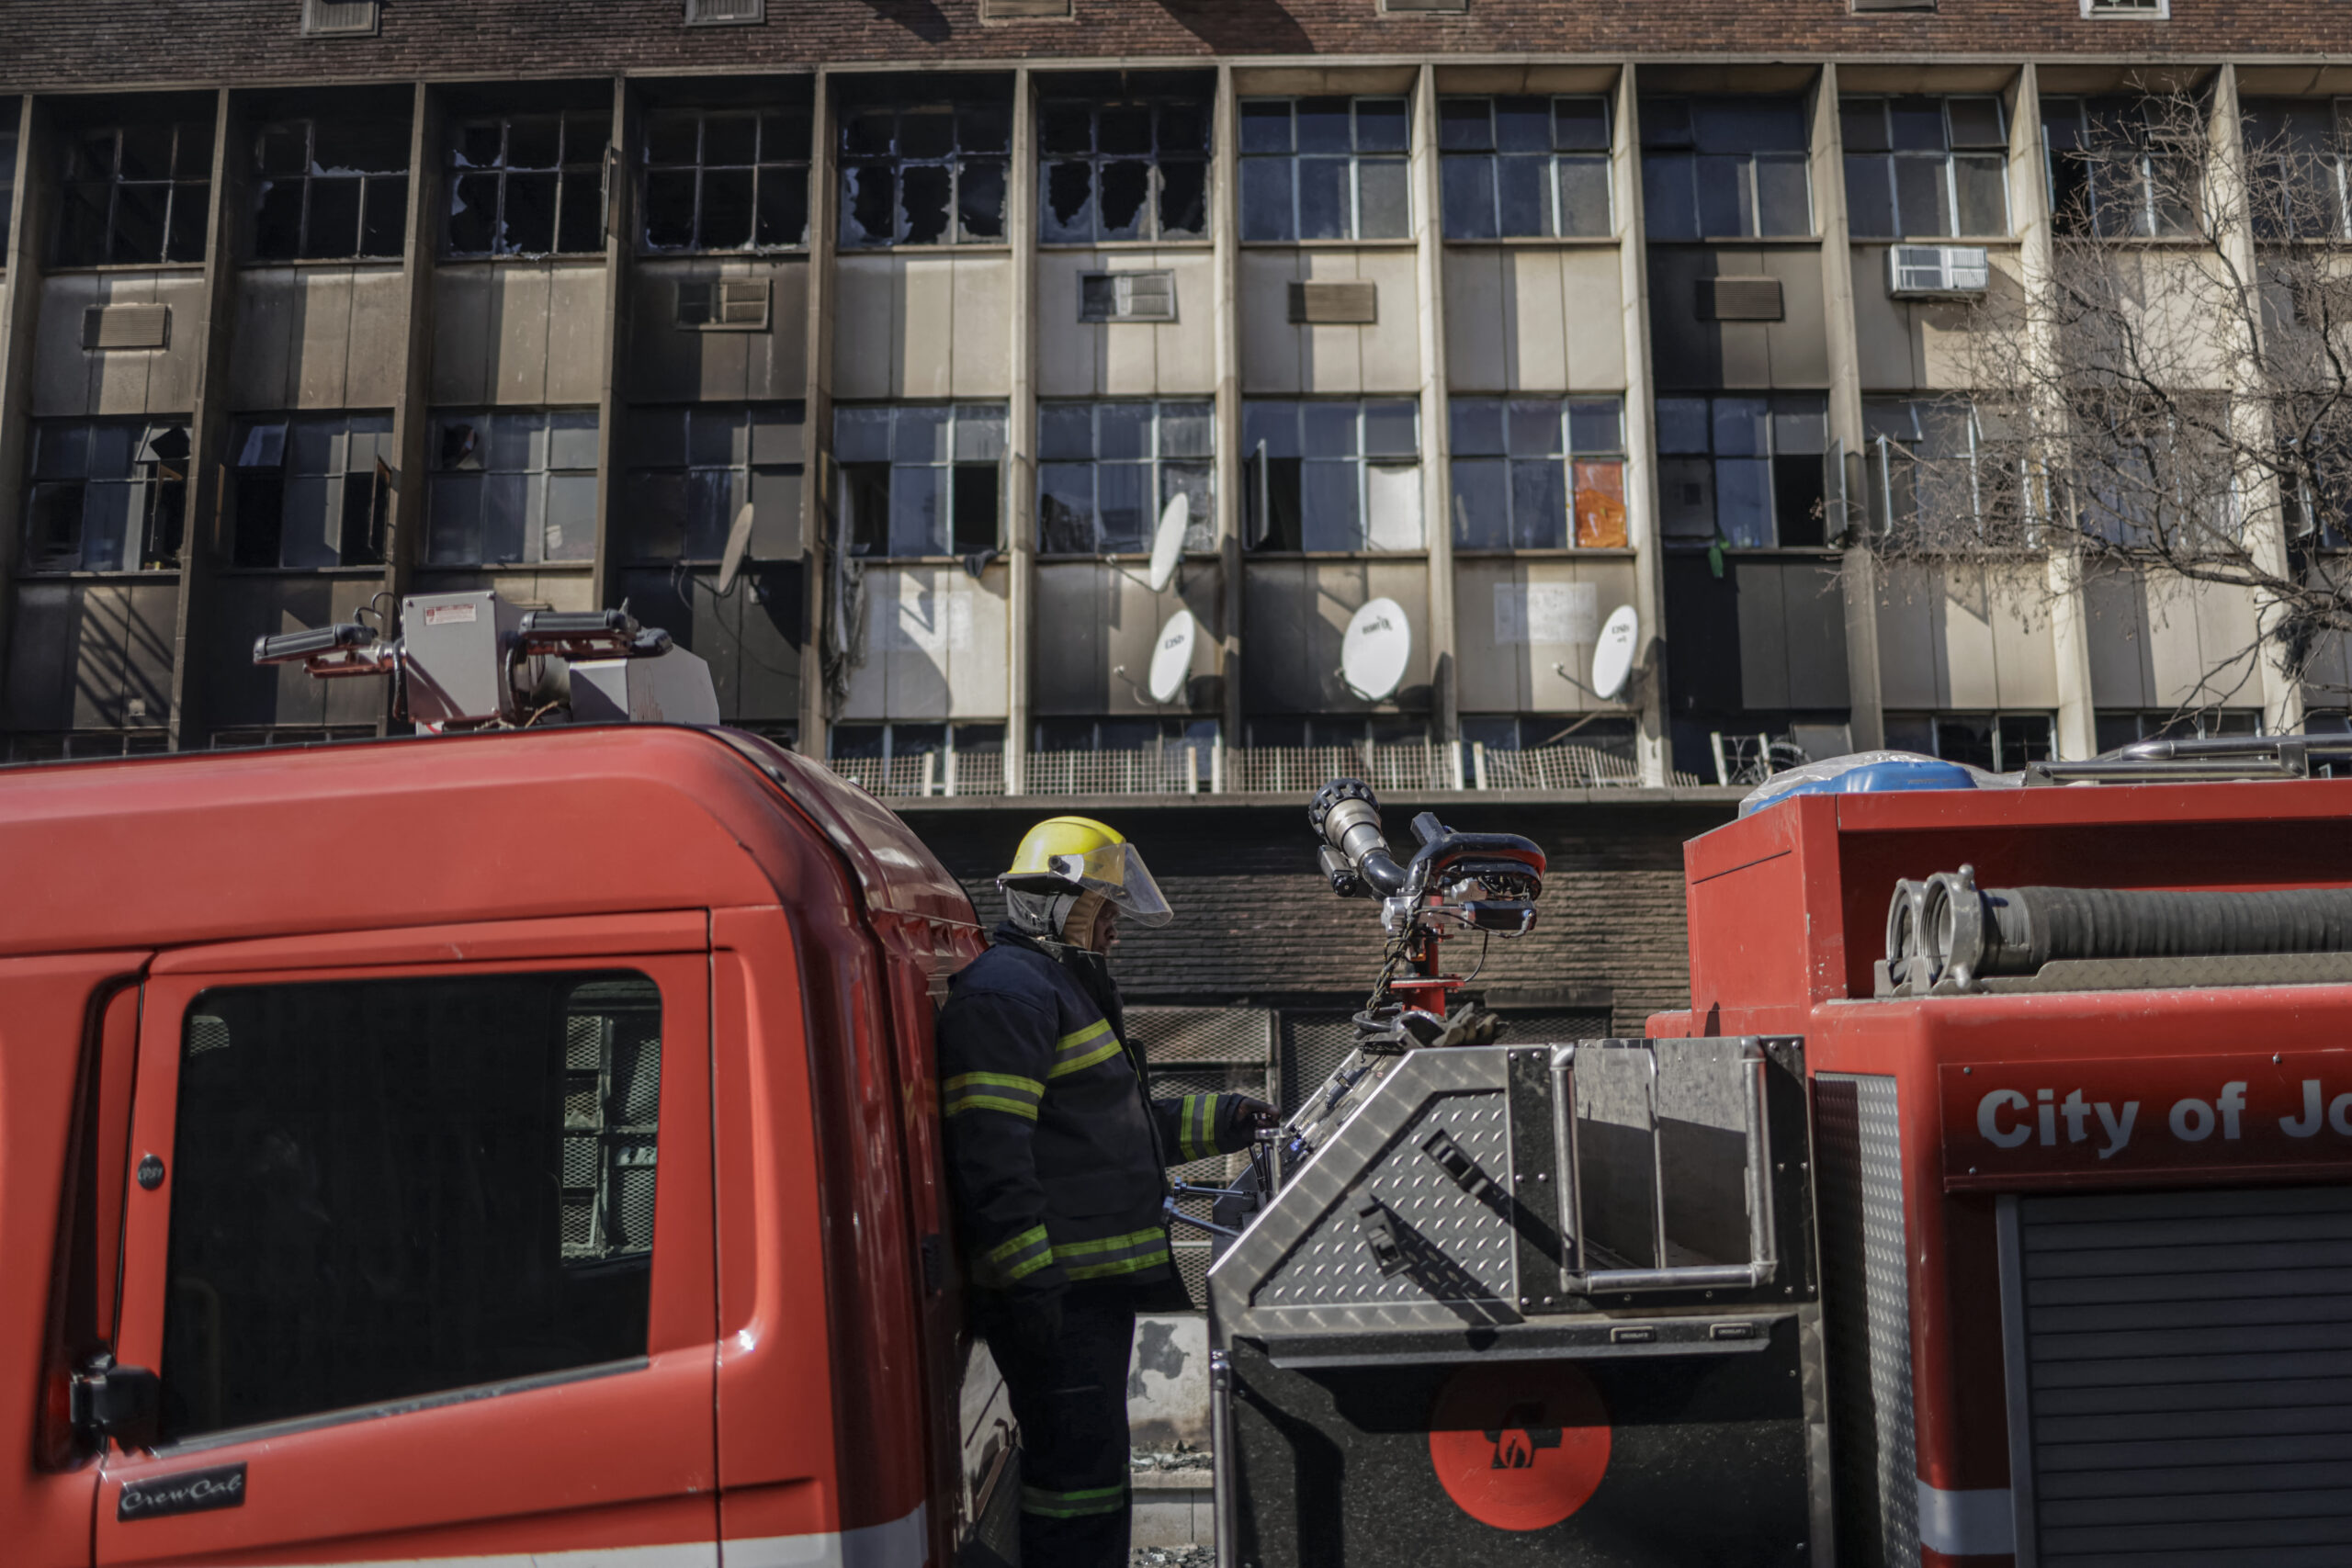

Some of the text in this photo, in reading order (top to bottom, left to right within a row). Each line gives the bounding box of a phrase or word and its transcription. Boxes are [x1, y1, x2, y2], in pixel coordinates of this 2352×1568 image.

[1976, 1088, 2139, 1160] City
[2168, 1081, 2247, 1142] of
[121, 1473, 242, 1512] CrewCab
